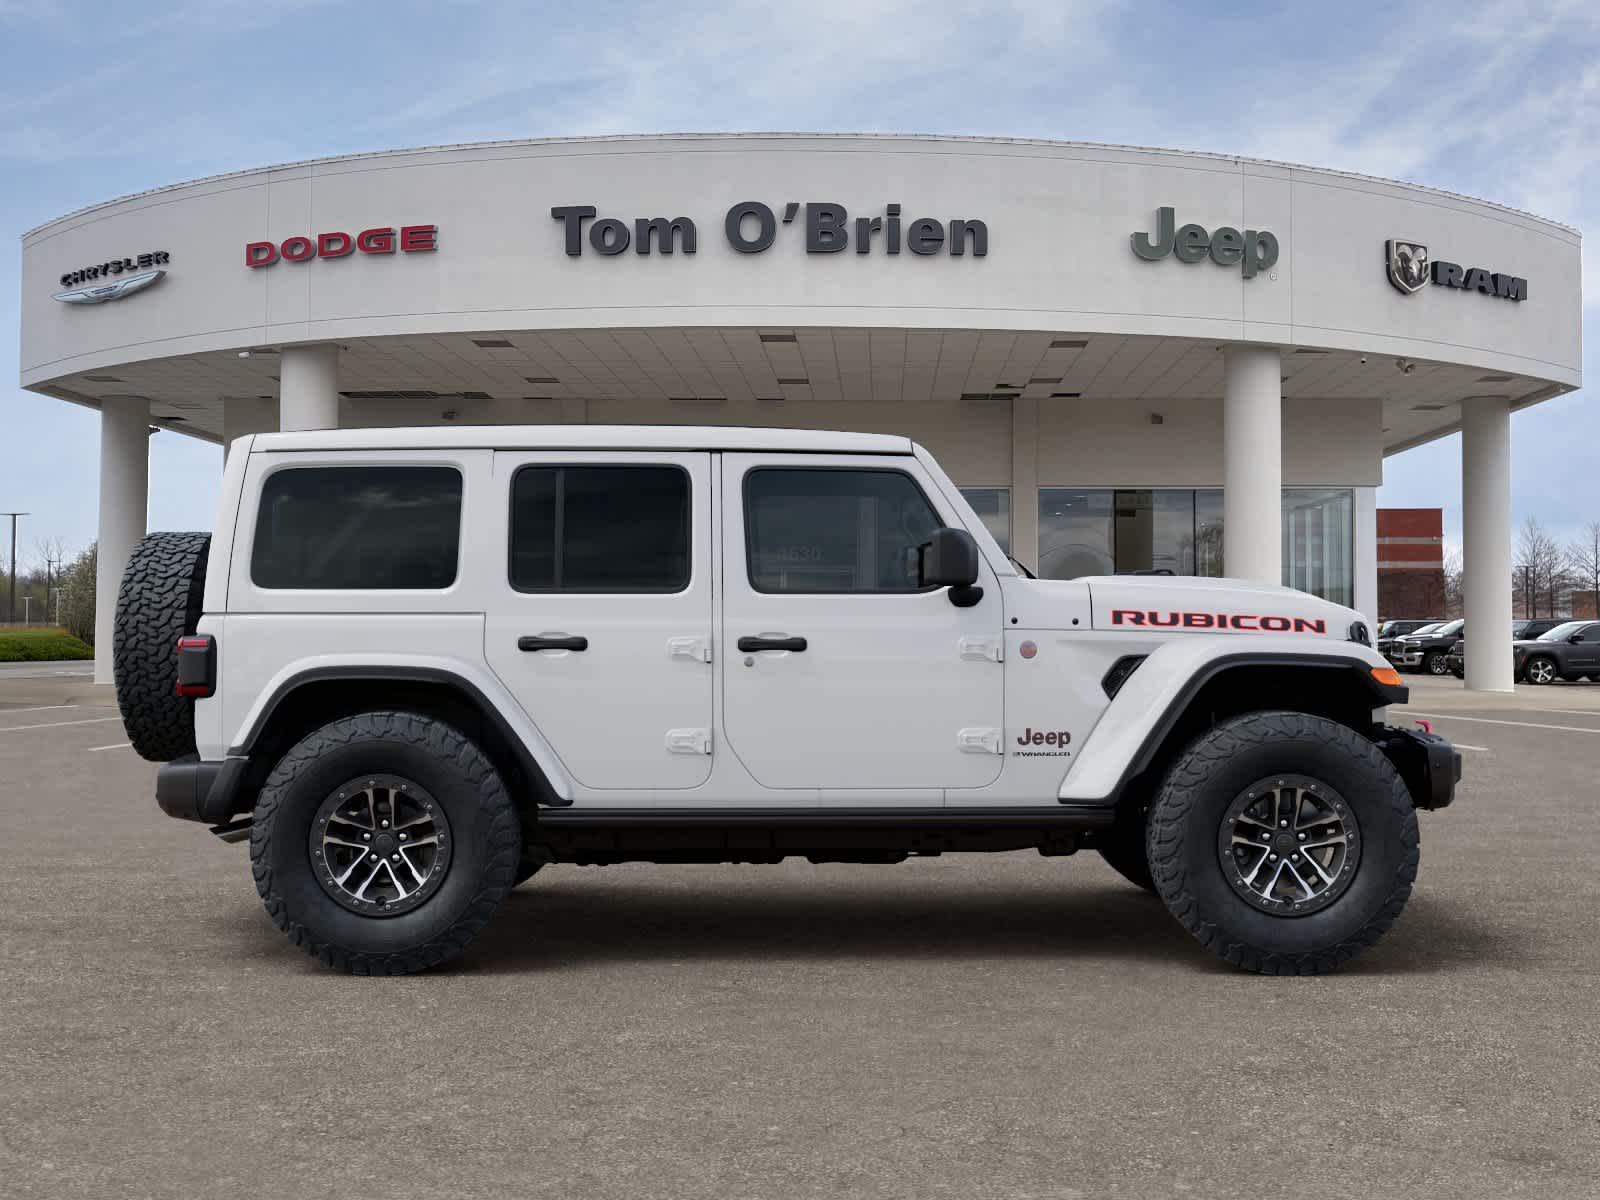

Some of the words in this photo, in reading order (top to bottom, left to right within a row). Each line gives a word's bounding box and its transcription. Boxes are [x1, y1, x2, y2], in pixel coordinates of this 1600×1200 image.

[245, 224, 438, 269] DODGE
[550, 205, 697, 257] Tom
[725, 201, 989, 257] O'Brien
[1130, 206, 1279, 279] Jeep
[60, 250, 170, 287] CHRYSLER
[1431, 260, 1528, 302] RAM
[1111, 609, 1327, 634] RUBICON
[1017, 727, 1071, 749] Jeep
